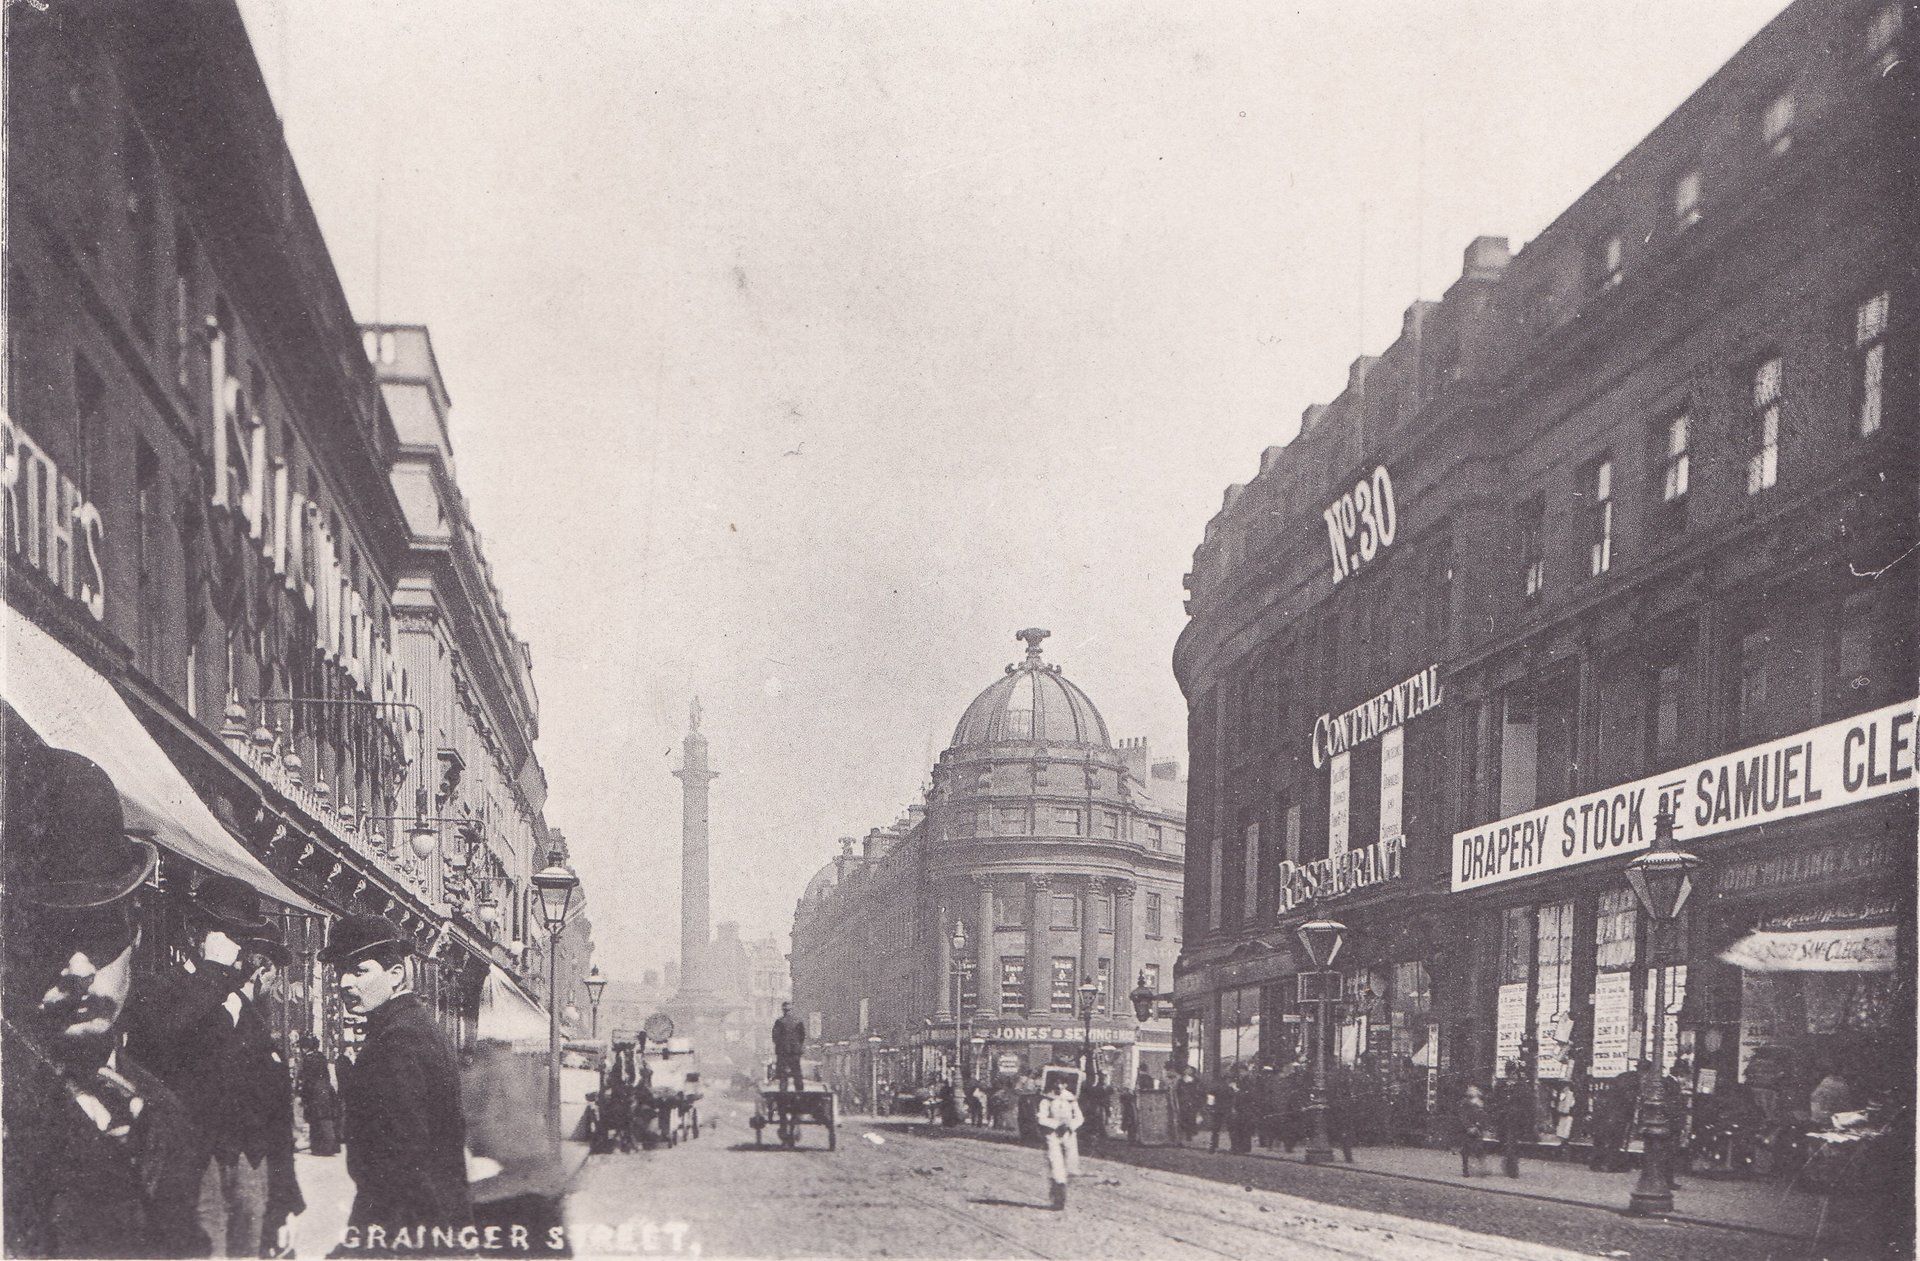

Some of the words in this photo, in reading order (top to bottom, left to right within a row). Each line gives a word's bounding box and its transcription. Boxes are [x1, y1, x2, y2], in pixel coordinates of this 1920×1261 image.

[1312, 664, 1443, 769] CONTINENTAL
[1461, 815, 1548, 884] DRAPERY
[1561, 788, 1645, 858] STOCK
[1695, 741, 1822, 827] SAMUEL
[1843, 711, 1919, 793] CLE
[1277, 834, 1407, 914] RESTAURANT
